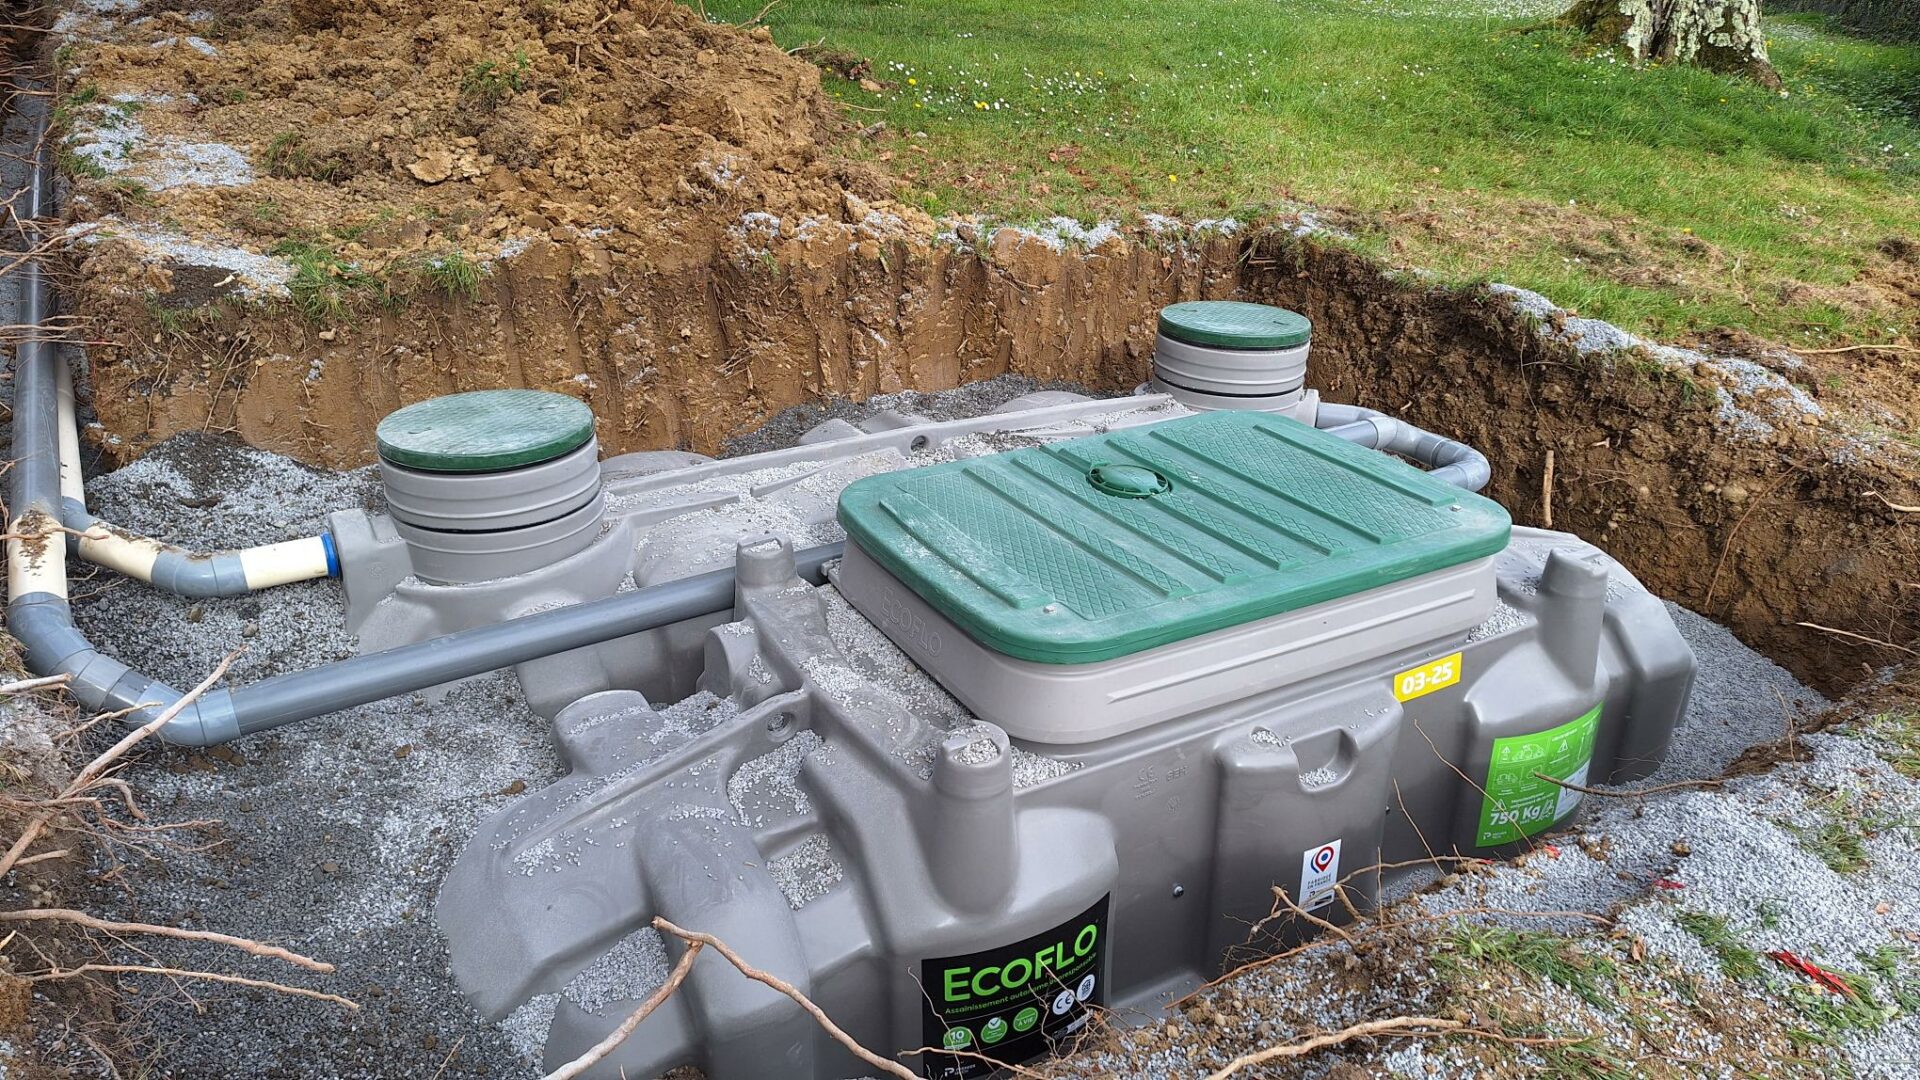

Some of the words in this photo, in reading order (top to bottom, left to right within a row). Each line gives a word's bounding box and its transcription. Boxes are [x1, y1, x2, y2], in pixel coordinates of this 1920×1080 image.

[880, 586, 942, 657] ECOFLO
[1401, 661, 1454, 696] 03-25
[1489, 809, 1520, 827] 750
[1522, 805, 1541, 820] Kg
[944, 923, 1098, 1003] ECOFLO
[944, 995, 1009, 1015] Assainissement
[950, 1030, 965, 1040] 10
